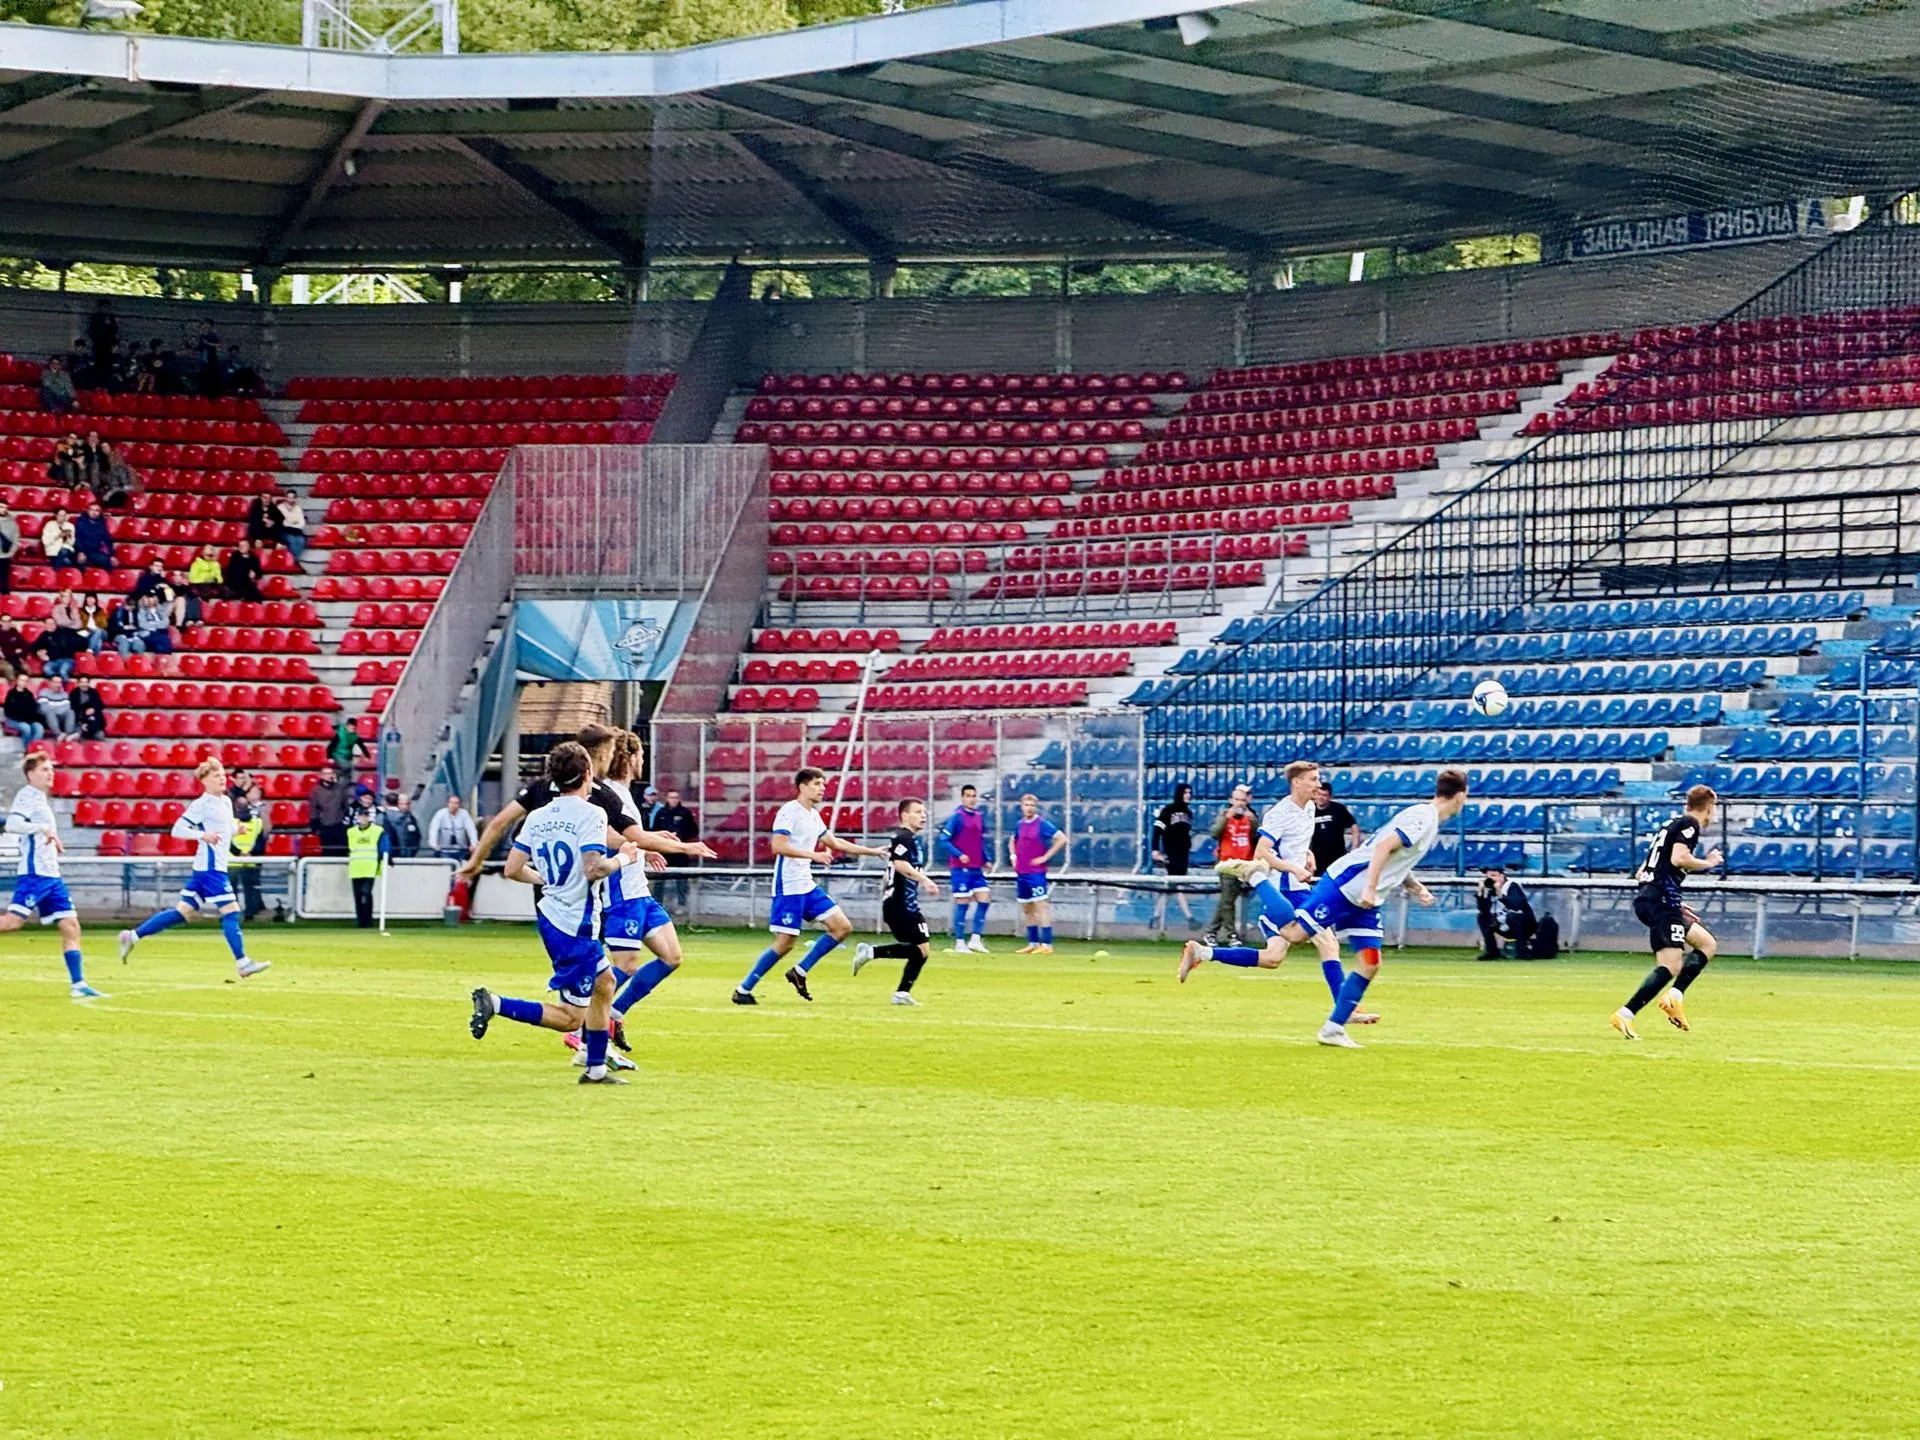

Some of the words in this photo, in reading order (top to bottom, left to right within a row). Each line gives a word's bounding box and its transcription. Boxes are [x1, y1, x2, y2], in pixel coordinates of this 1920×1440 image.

[1582, 216, 1688, 253] ЗАПАДНАЯ
[1703, 204, 1793, 240] ТРИБУНА
[537, 840, 574, 886] 19
